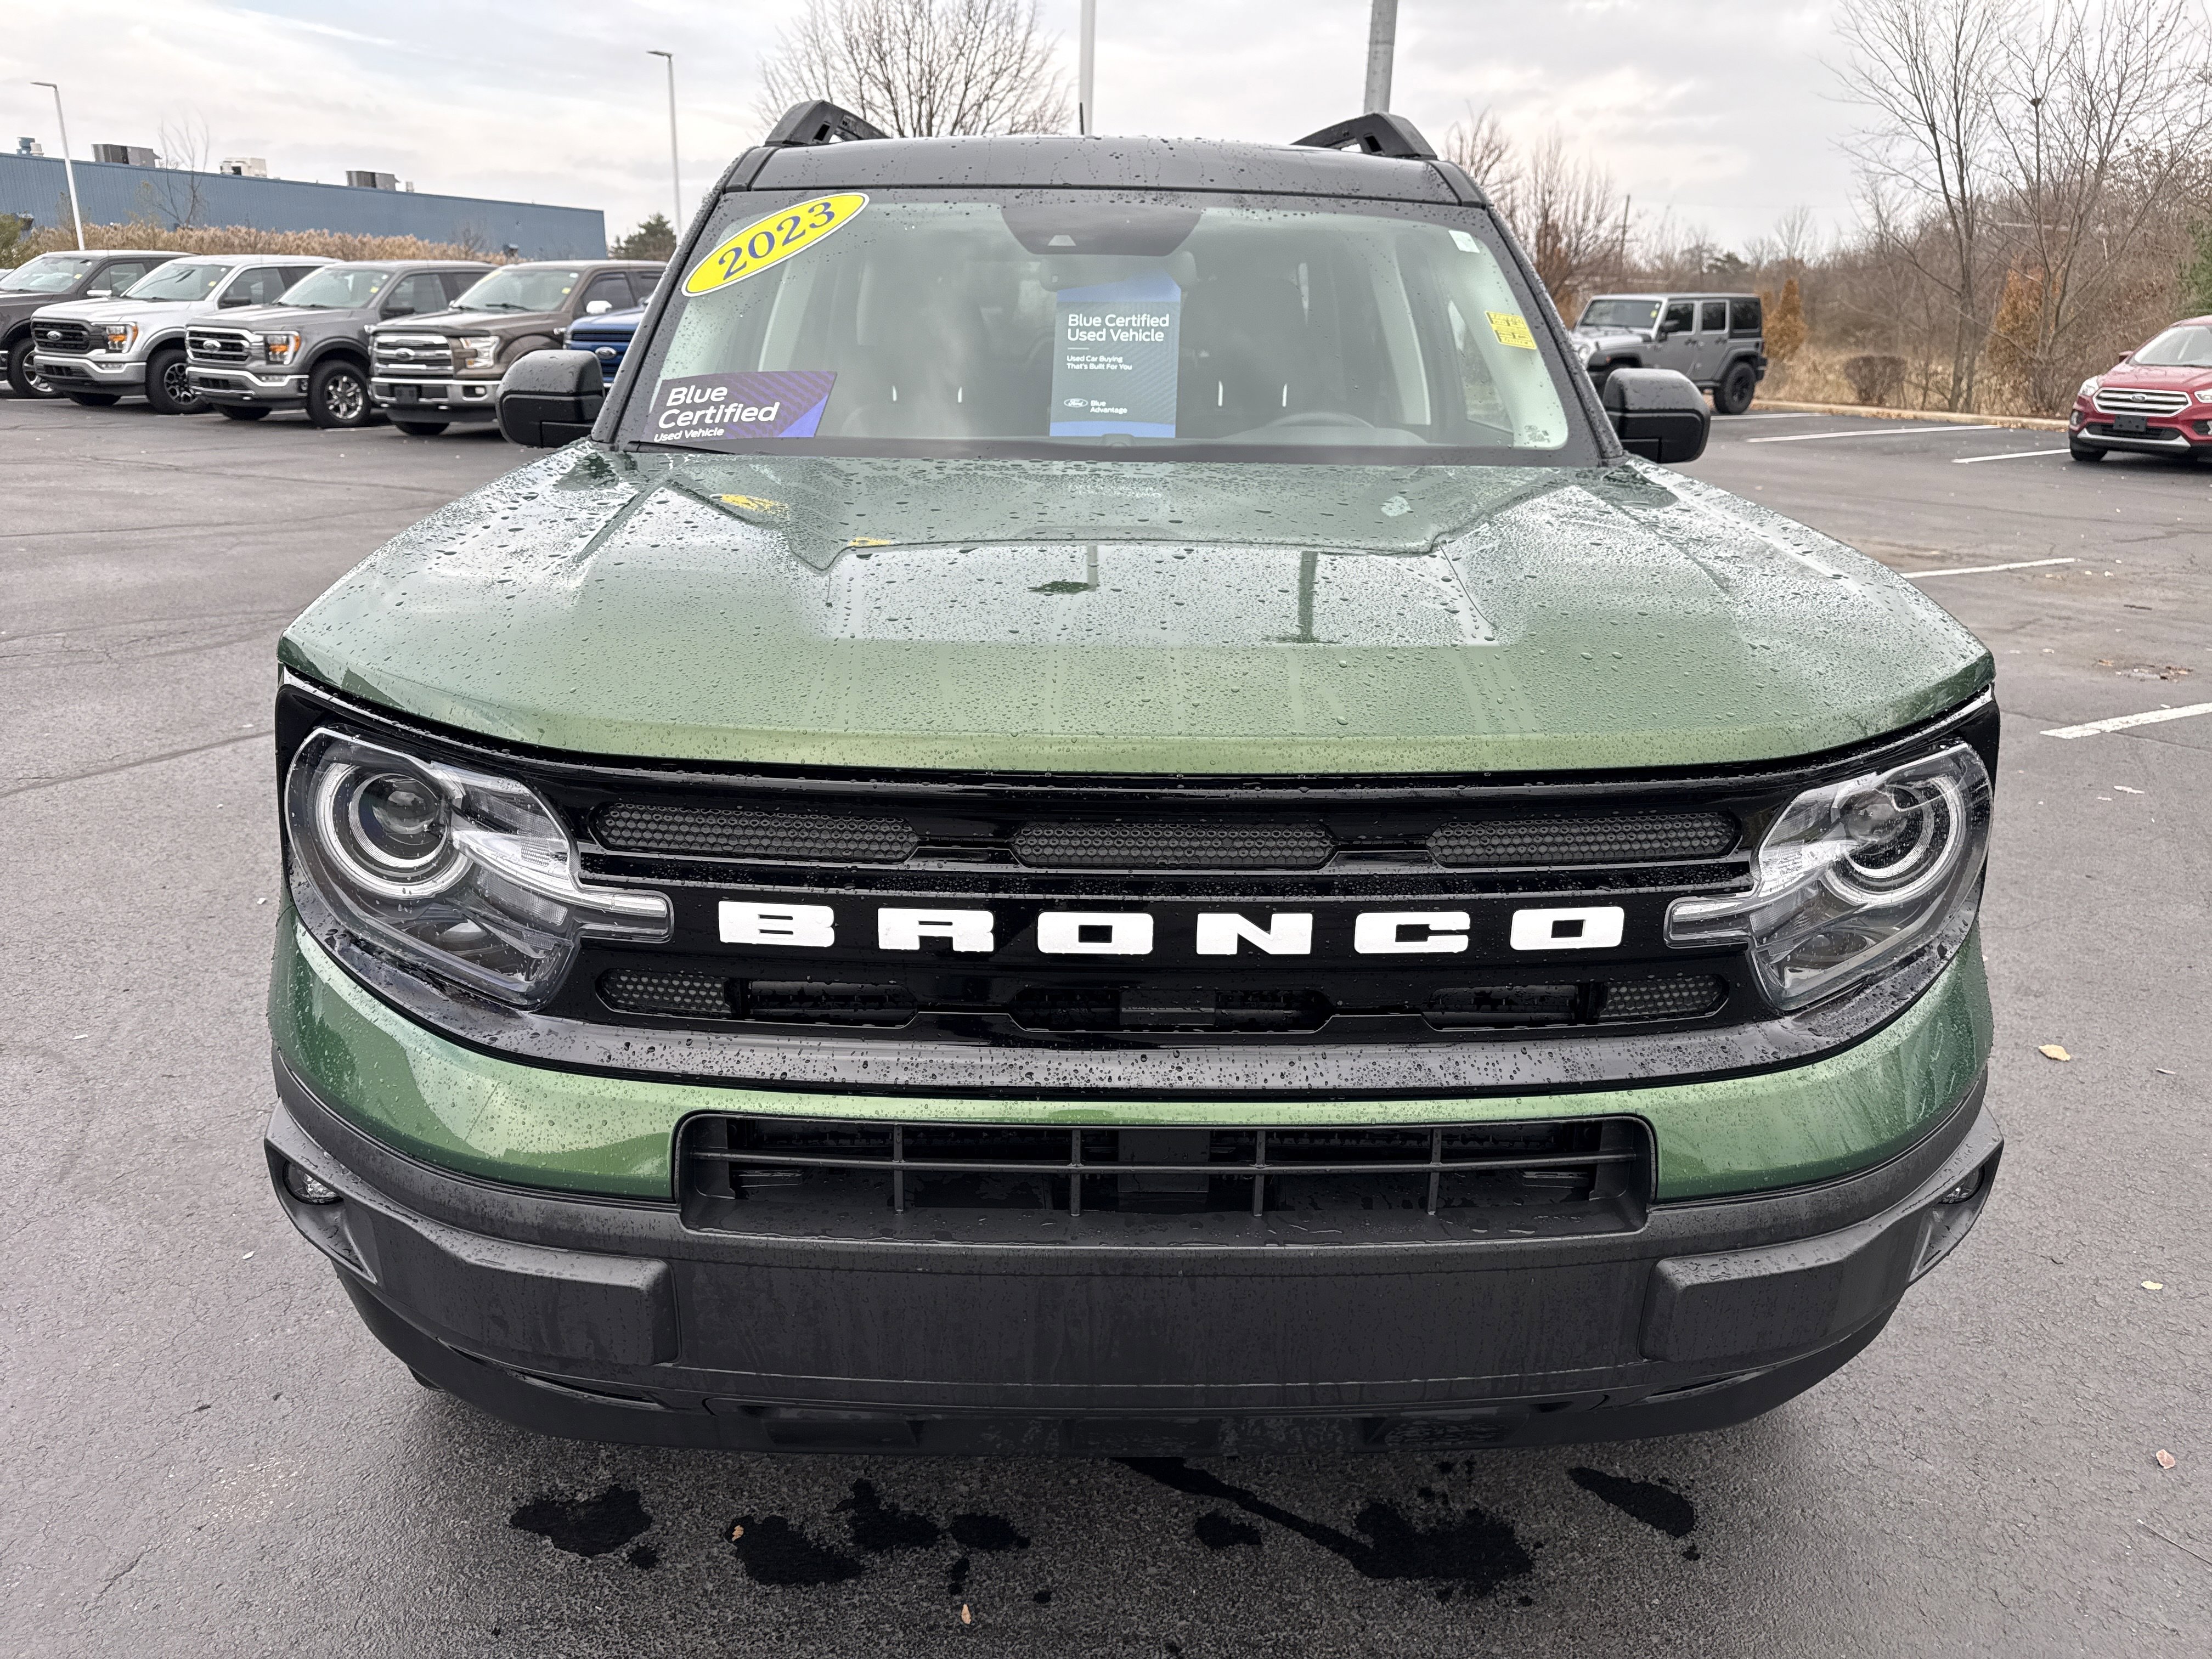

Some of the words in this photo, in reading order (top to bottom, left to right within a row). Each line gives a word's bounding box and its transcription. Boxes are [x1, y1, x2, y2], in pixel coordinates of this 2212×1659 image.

[718, 202, 836, 280] 2023
[1068, 314, 1102, 327] Blue
[1105, 313, 1170, 327] Certified
[1067, 328, 1107, 341] Used
[1110, 329, 1164, 342] Vehicle
[666, 385, 728, 407] Blue
[658, 402, 780, 428] Certified
[654, 430, 682, 443] Used
[684, 427, 725, 439] Vehicle
[718, 900, 1625, 955] BRONCO
